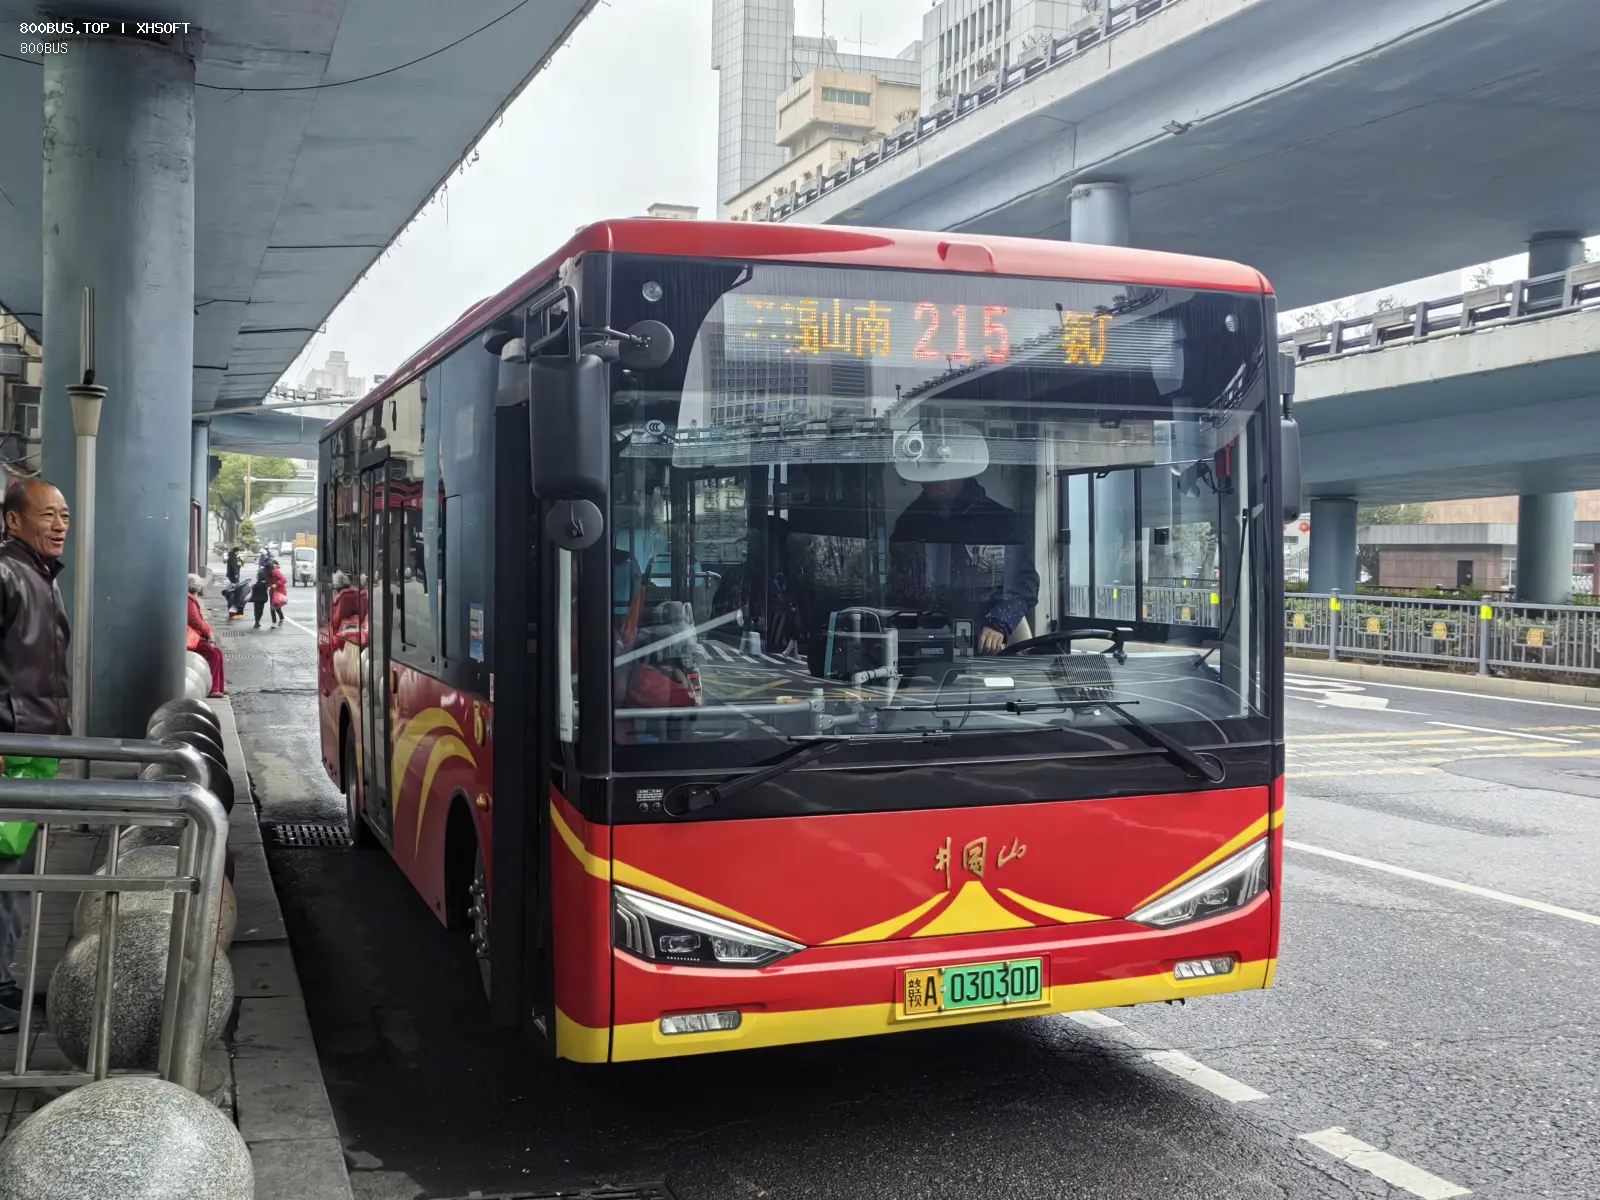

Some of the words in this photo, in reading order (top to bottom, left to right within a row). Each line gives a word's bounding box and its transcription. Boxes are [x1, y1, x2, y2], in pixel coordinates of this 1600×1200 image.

[914, 302, 1010, 364] 215
[907, 975, 938, 1008] 赣A
[950, 965, 1039, 1003] 03030D
